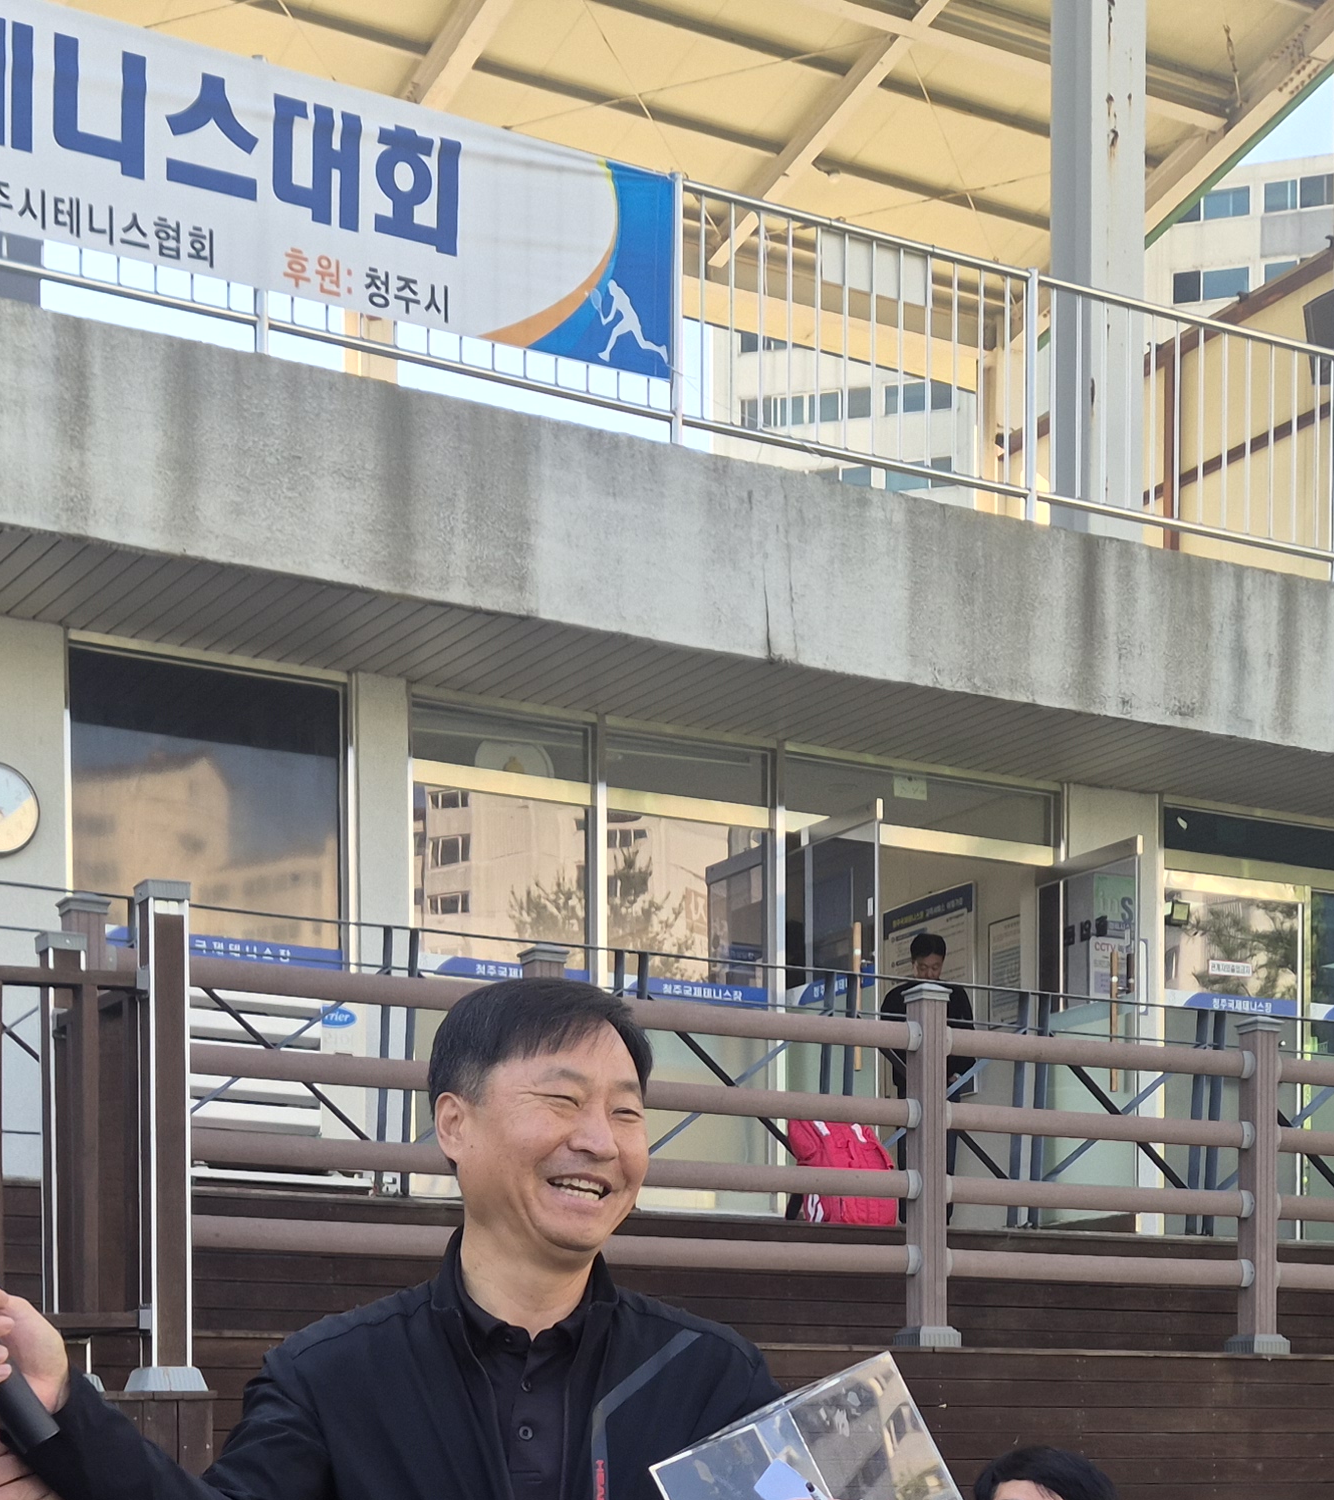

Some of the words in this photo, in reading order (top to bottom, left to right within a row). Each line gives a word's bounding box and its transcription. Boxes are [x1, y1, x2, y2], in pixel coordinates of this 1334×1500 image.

[284, 248, 355, 298] 후원:
[364, 268, 450, 323] 청주시
[194, 939, 291, 963] 국제테니스장
[1094, 941, 1116, 952] CCTV
[475, 963, 522, 979] 청주국제
[662, 983, 742, 1001] 청주국제테니스장
[1212, 998, 1272, 1013] 청주국제테니스장
[325, 1010, 351, 1022] rrier
